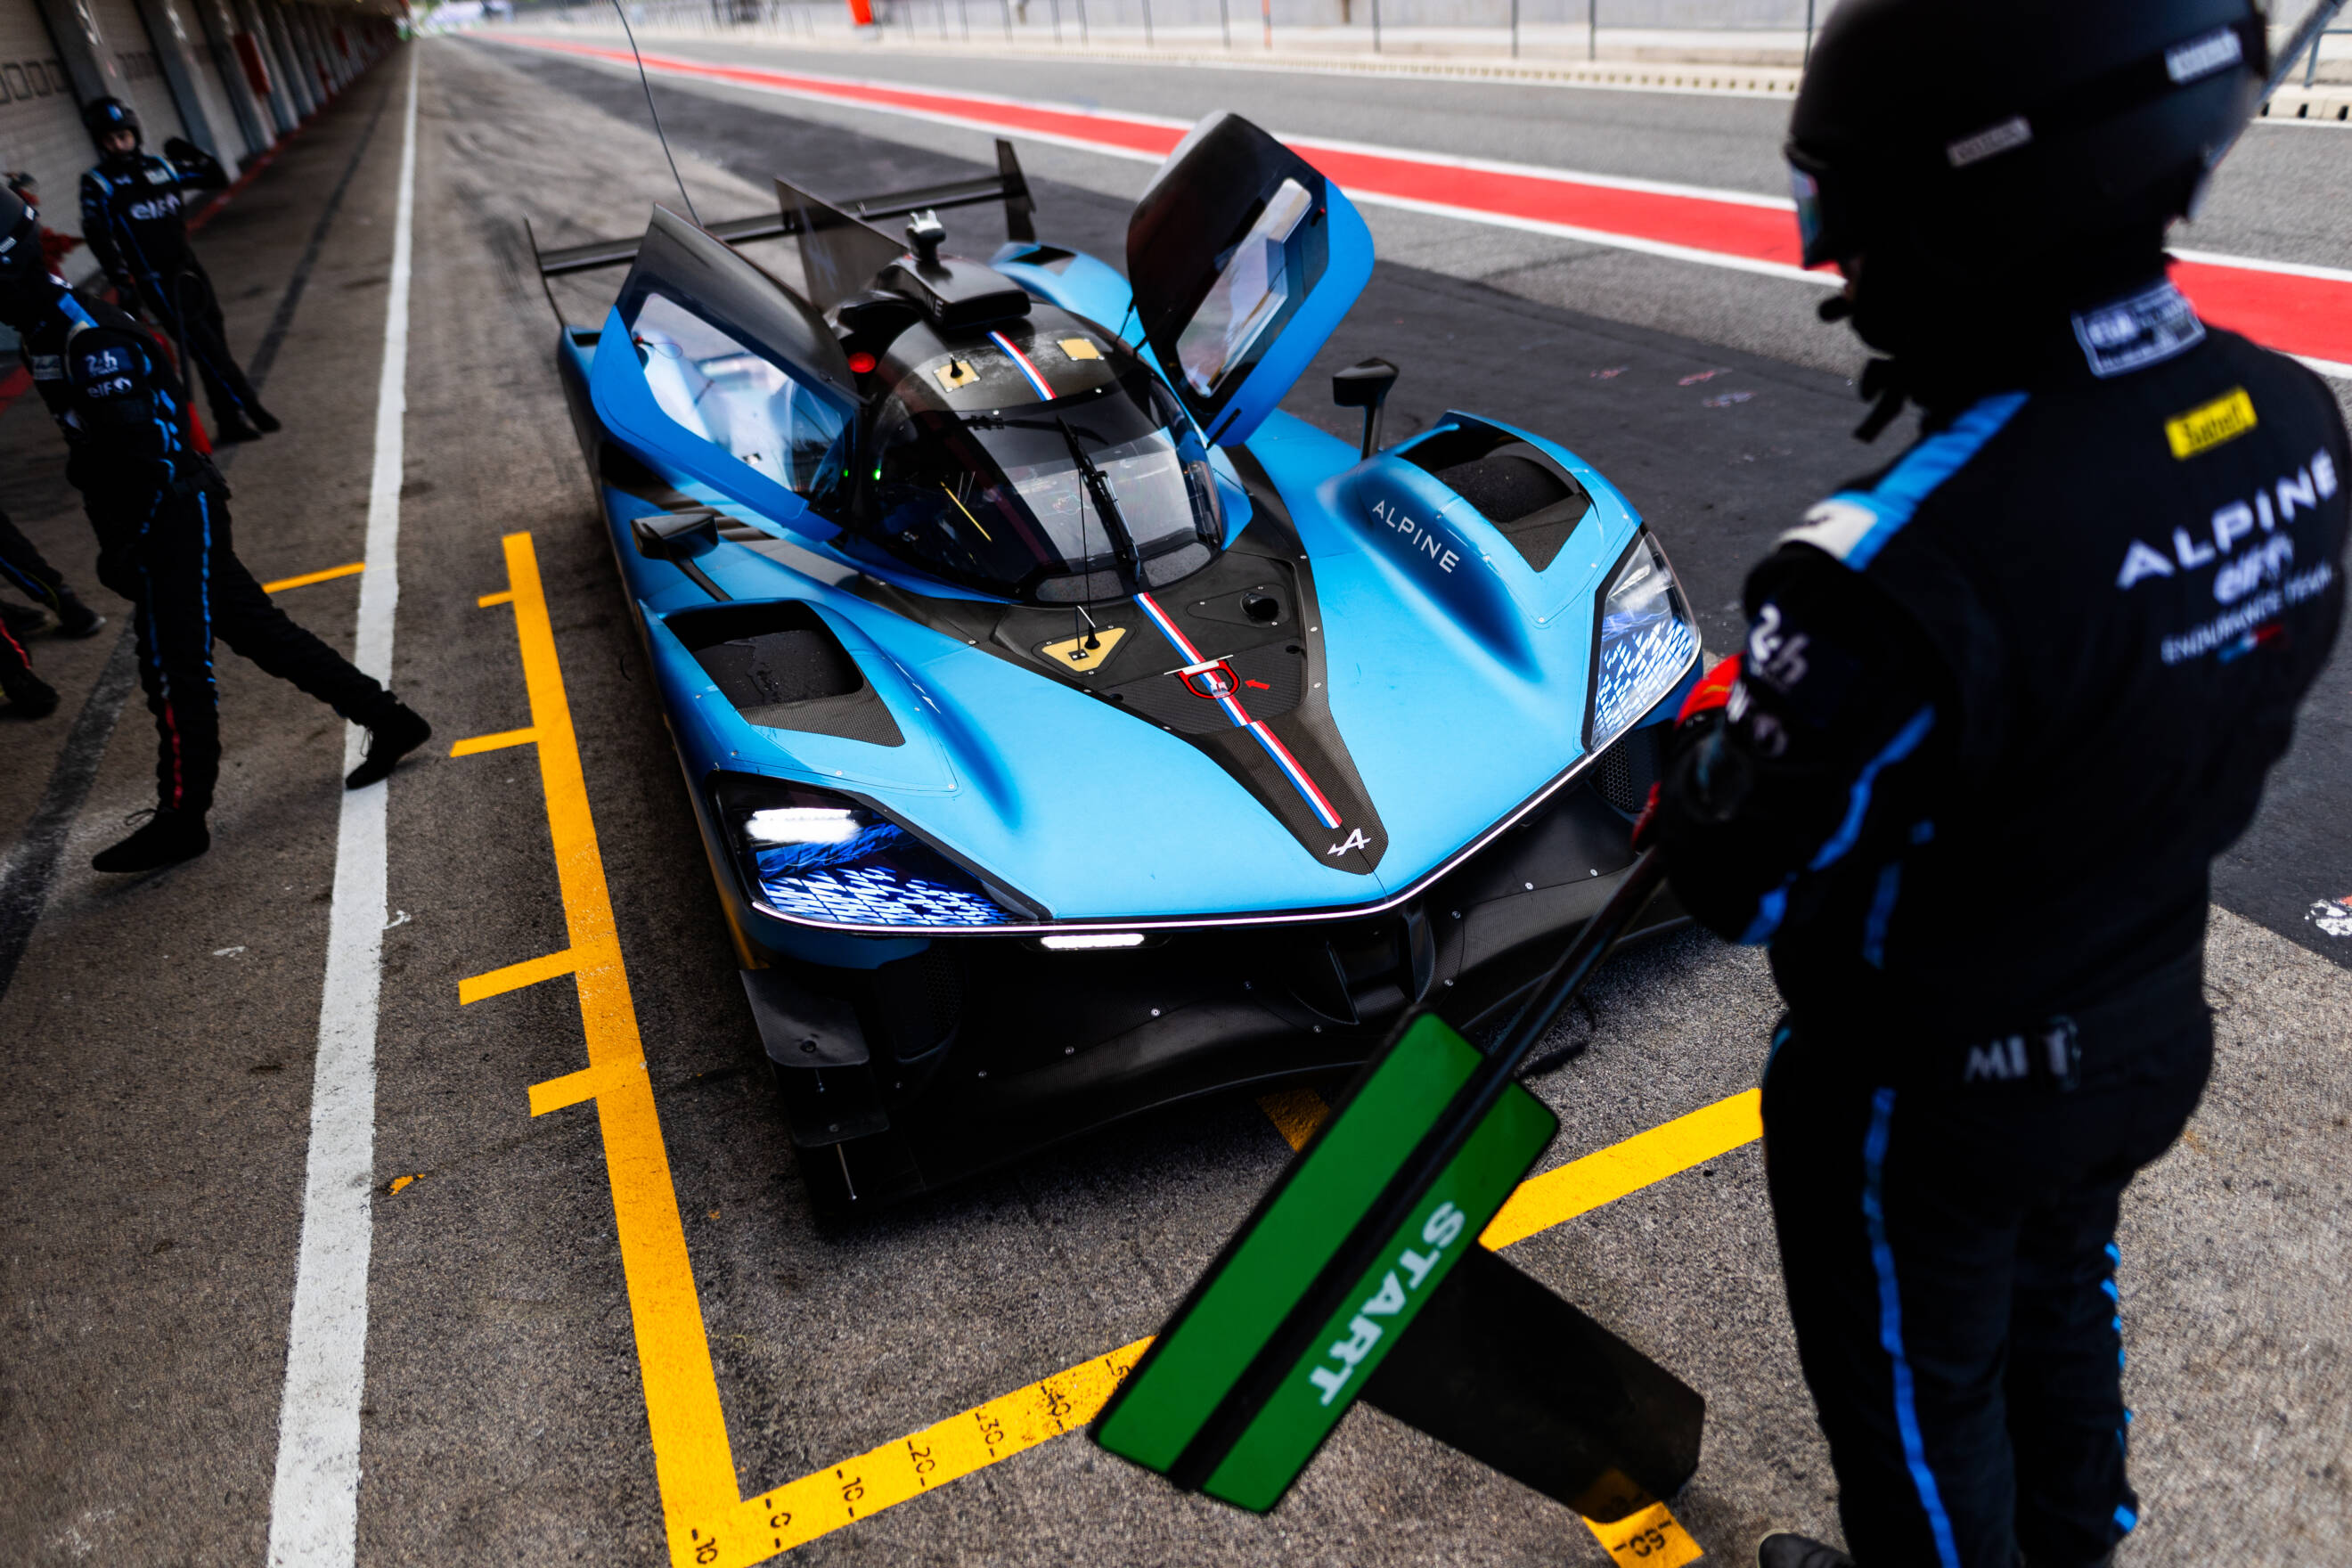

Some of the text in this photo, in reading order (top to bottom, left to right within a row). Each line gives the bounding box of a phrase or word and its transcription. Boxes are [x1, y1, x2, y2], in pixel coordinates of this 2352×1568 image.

[1372, 499, 1460, 574] ALPINE
[2115, 446, 2338, 590] ALPINE
[1307, 1200, 1466, 1407] START
